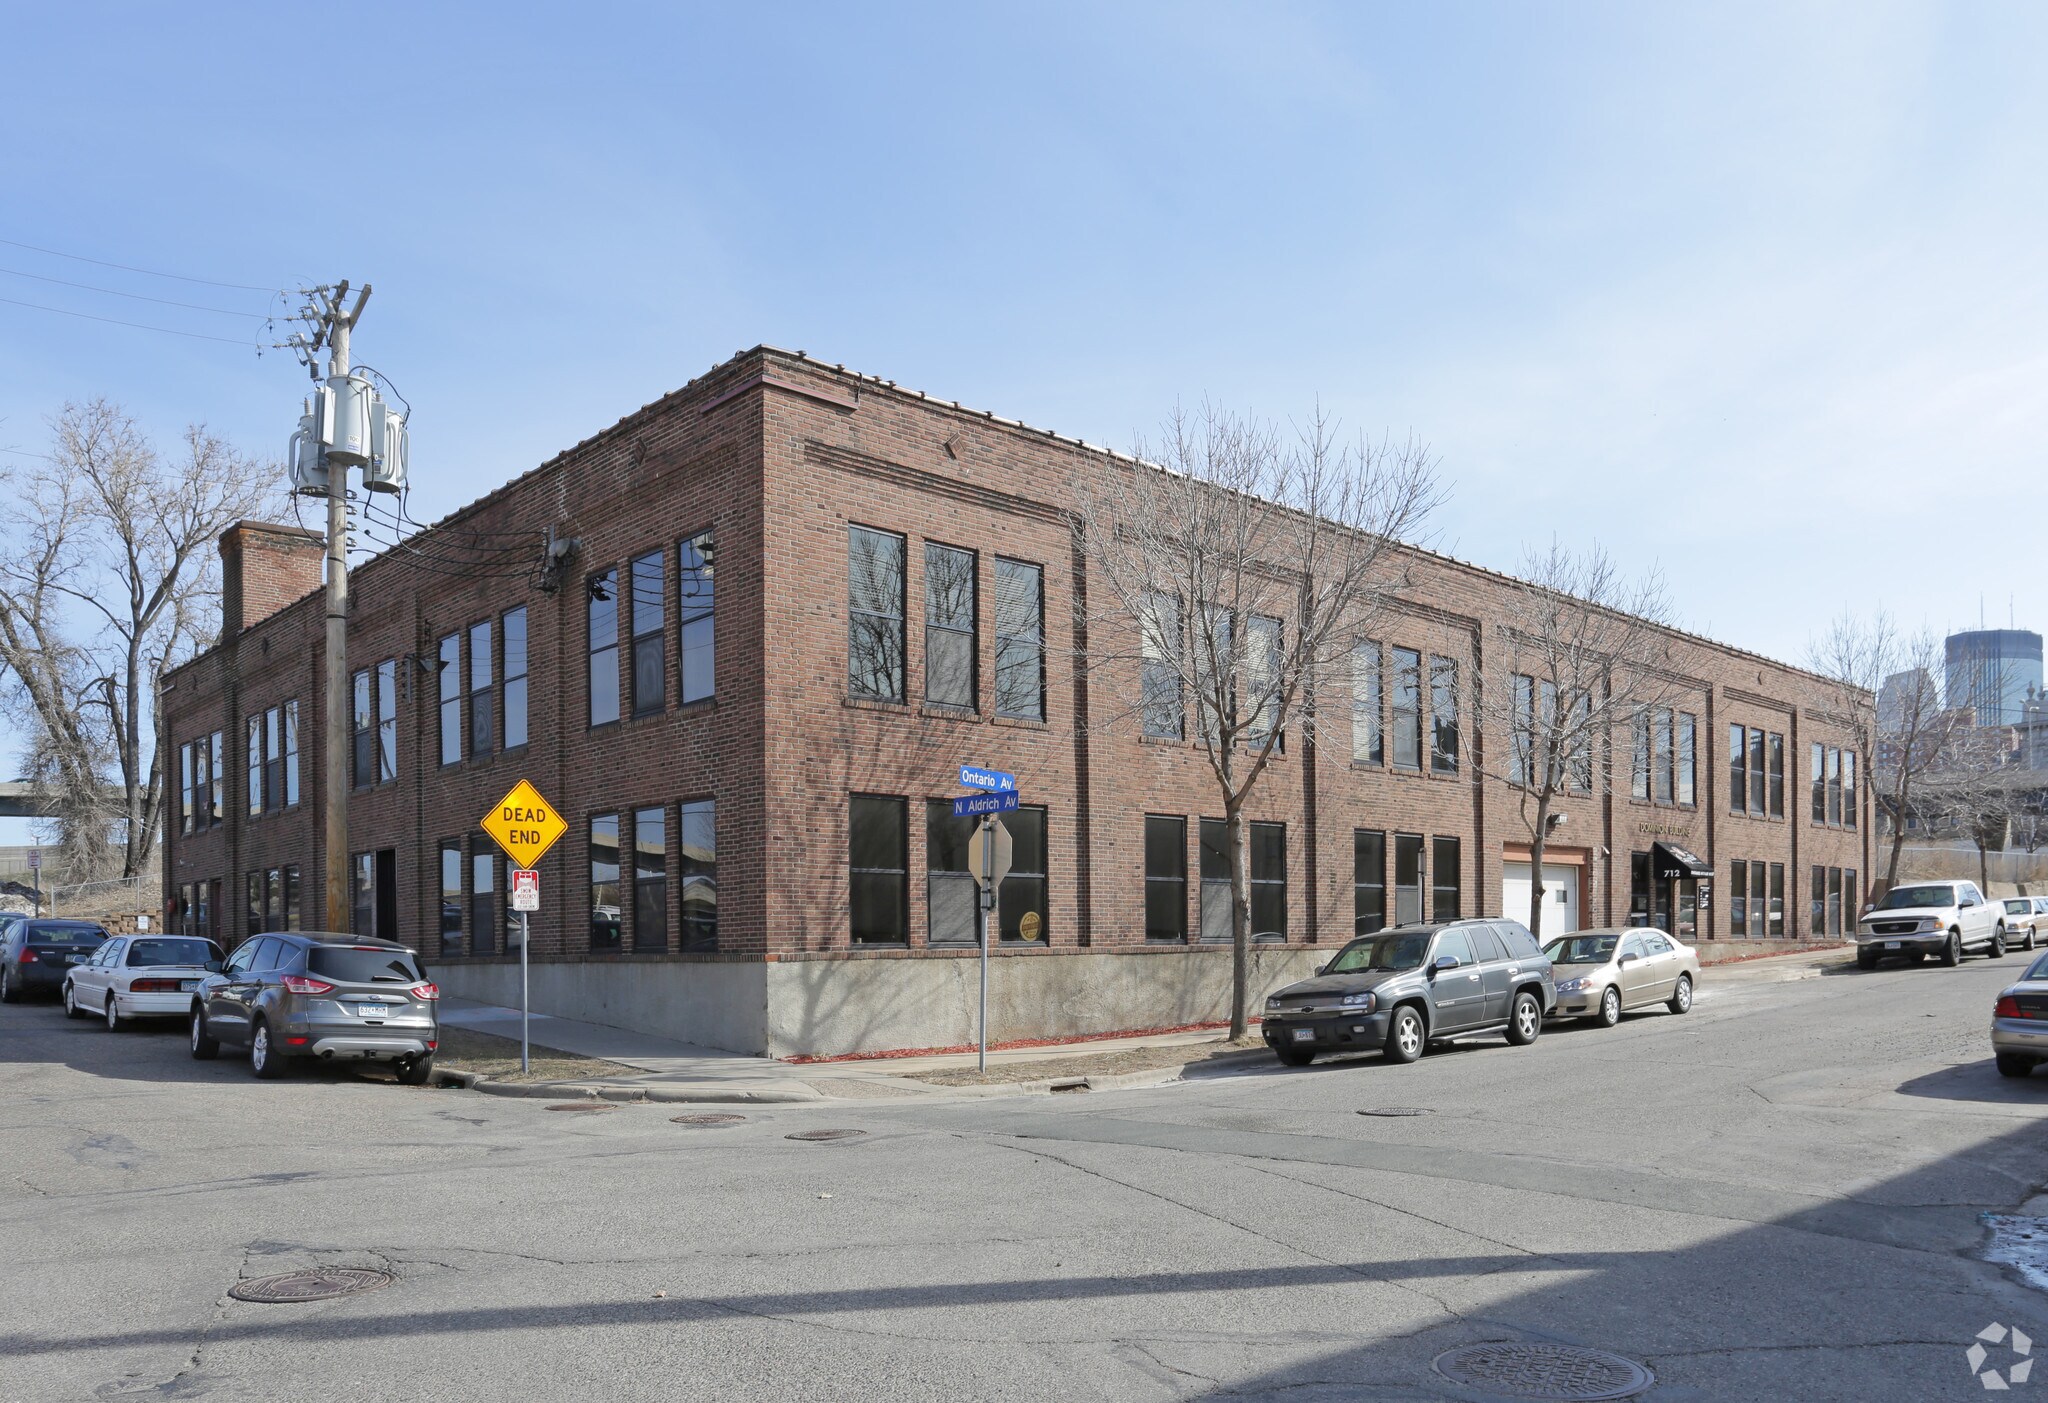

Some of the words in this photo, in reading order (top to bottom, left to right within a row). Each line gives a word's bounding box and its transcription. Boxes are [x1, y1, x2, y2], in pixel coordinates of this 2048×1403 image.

[962, 769, 995, 787] Ontario
[1000, 776, 1013, 790] Av
[955, 801, 962, 813] N
[968, 798, 999, 812] Aldrich
[1005, 795, 1017, 808] Av
[504, 807, 546, 822] DEAD
[510, 830, 540, 844] END
[1640, 822, 1668, 835] DOMINION
[1669, 825, 1691, 837] BUILDING
[1664, 869, 1680, 878] 712
